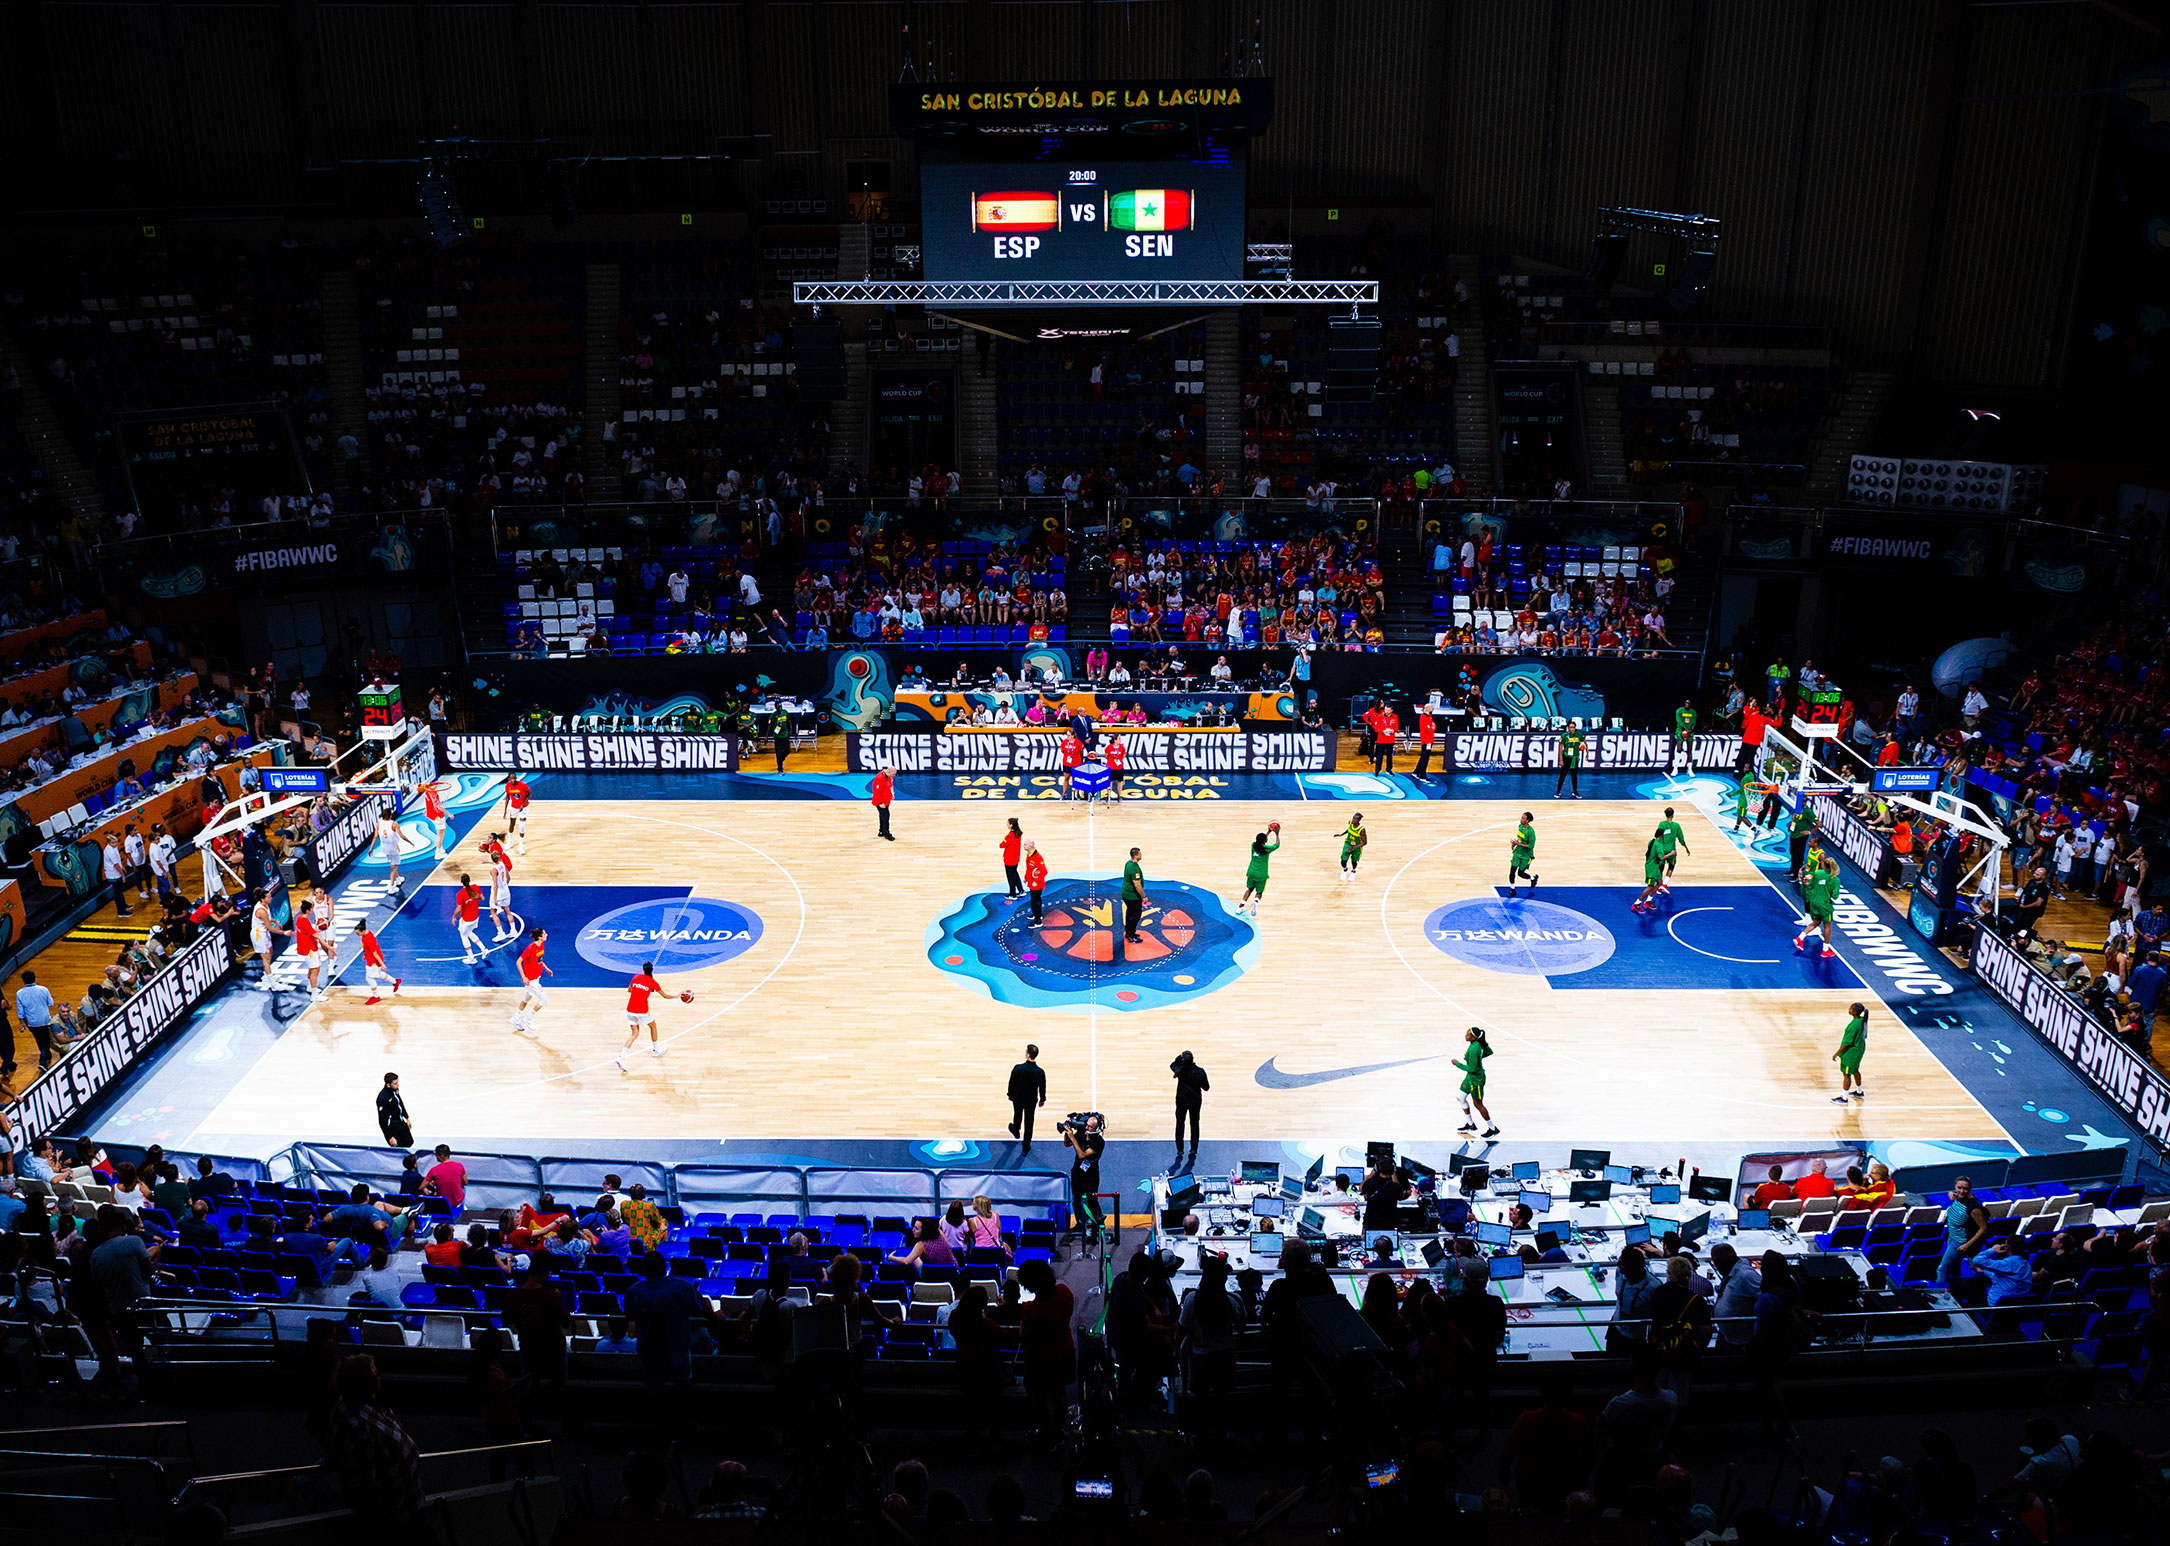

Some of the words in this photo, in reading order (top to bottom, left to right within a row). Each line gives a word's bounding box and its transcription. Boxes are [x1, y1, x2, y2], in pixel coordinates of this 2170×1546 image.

[921, 93, 960, 110] SAN
[968, 87, 1083, 110] CRISTÓBAL
[1092, 91, 1117, 108] DE
[1124, 90, 1150, 107] LA
[1158, 88, 1242, 107] LAGUNA
[1069, 170, 1096, 181] 20:00
[1070, 204, 1096, 222] VS
[994, 236, 1040, 259] ESP
[1125, 234, 1173, 257] SEN
[148, 424, 175, 437] SAN
[153, 436, 173, 448] DE
[176, 434, 195, 446] LA
[200, 431, 254, 444] LAGUNA
[1830, 536, 1931, 559] #FIBAWWC
[234, 543, 338, 572] #FIBAWWC
[364, 695, 388, 706] 13:06
[1815, 692, 1841, 703] 13:06
[364, 707, 388, 726] 24
[1811, 704, 1837, 724] 24
[446, 736, 513, 762] SHINE
[517, 741, 586, 769] SHINE
[588, 736, 657, 762] SHINE
[660, 742, 728, 768] SHINE
[1454, 735, 1525, 762] SHINE
[1600, 735, 1670, 761] SHINE
[953, 776, 1022, 787] SAN
[1898, 773, 1930, 781] LOTERÍAS
[75, 782, 101, 799] WORLD
[101, 776, 116, 789] CUP
[962, 789, 1009, 799] DE
[1017, 788, 1062, 799] LA
[162, 805, 187, 821] WORLD
[316, 813, 351, 874] SHINE
[1812, 795, 1848, 843] SHINE
[1843, 824, 1883, 881] SHINE
[584, 929, 648, 941] 万达
[650, 929, 752, 941] WANDA
[1432, 930, 1498, 941] 万达
[1495, 930, 1606, 941] WANDA
[71, 1020, 133, 1105] SHINE
[127, 968, 184, 1044] SHINE
[181, 931, 229, 1006] SHINE
[1975, 931, 2029, 1006] SHINE
[2024, 980, 2082, 1061] SHINE
[2080, 1020, 2143, 1109] SHINE
